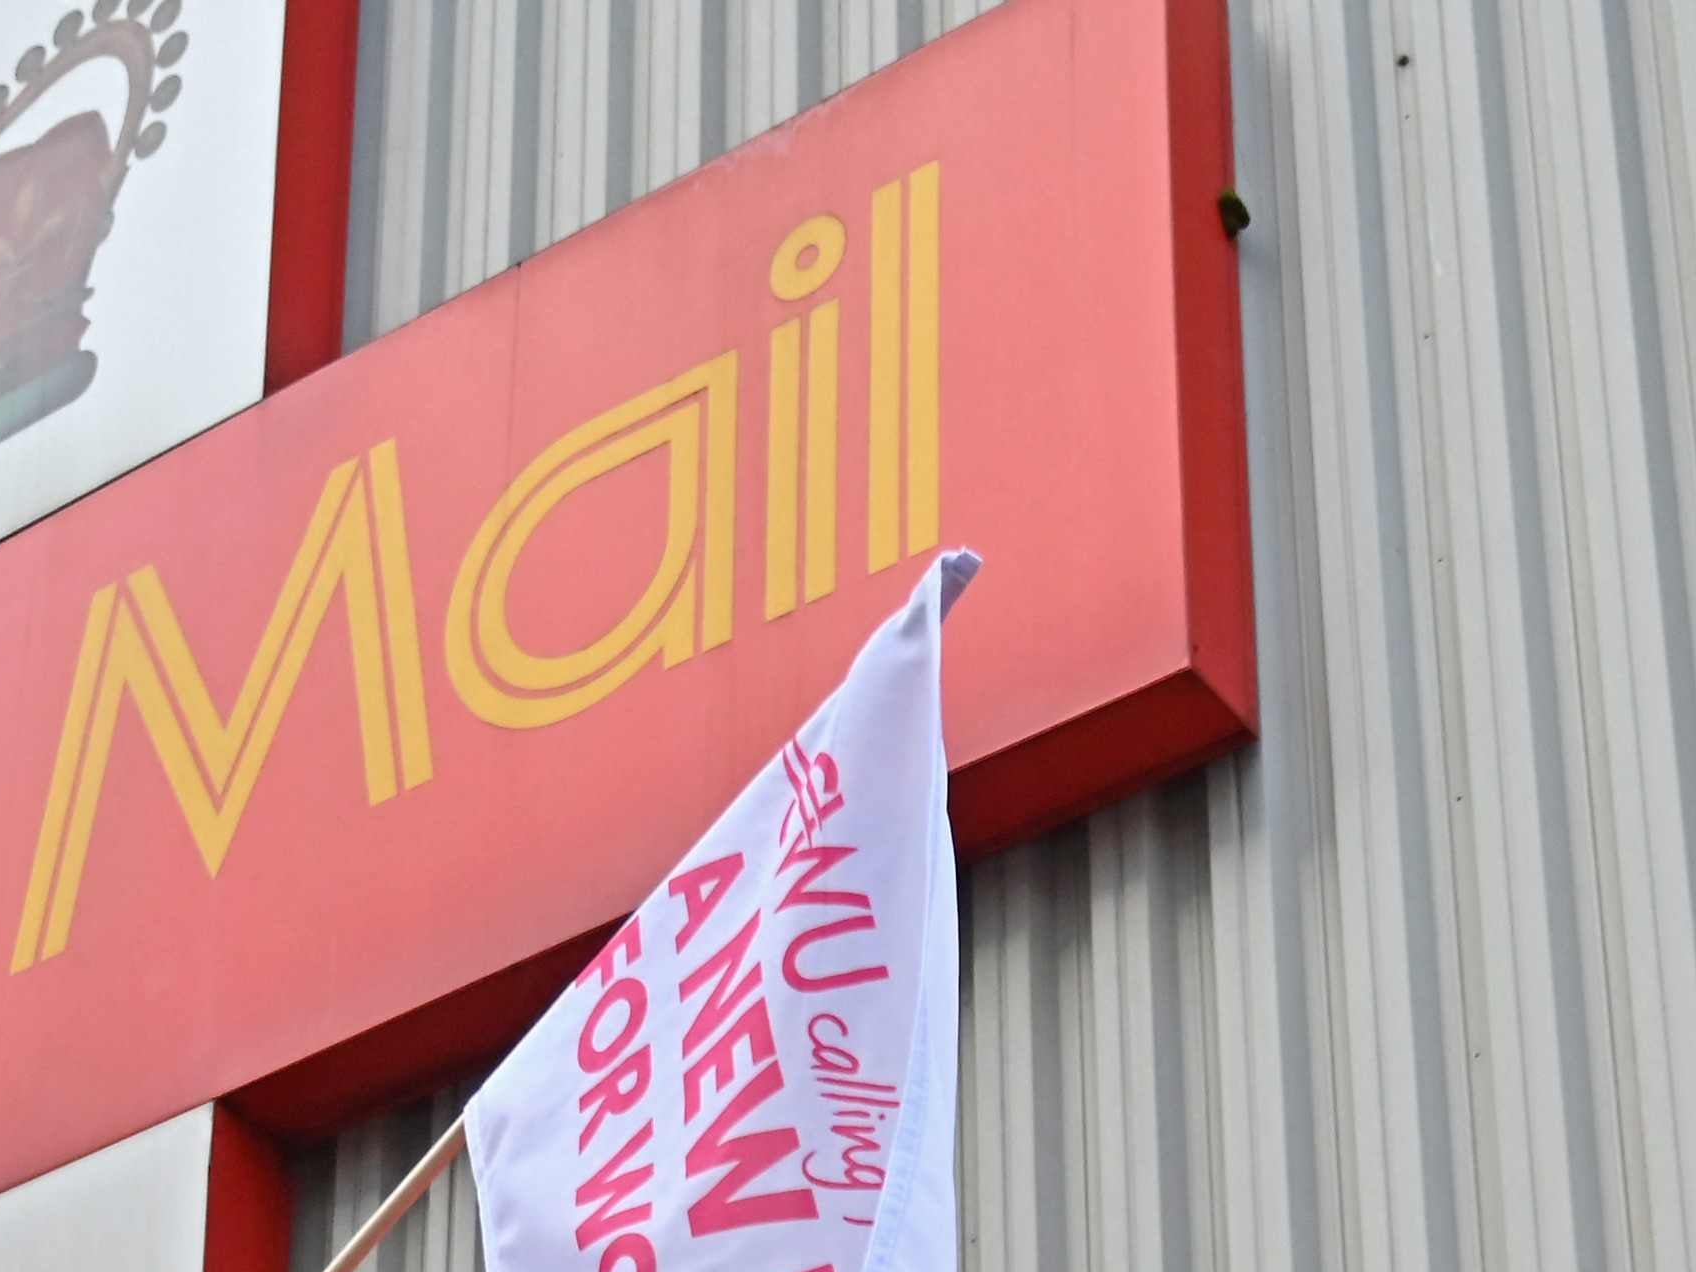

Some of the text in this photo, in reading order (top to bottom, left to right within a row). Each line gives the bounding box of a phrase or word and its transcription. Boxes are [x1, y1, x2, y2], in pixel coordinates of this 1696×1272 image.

[8, 160, 941, 976] Mail
[667, 852, 746, 956] A
[573, 915, 655, 1153] FOR
[678, 908, 820, 1238] NEW
[804, 1012, 902, 1192] calling
